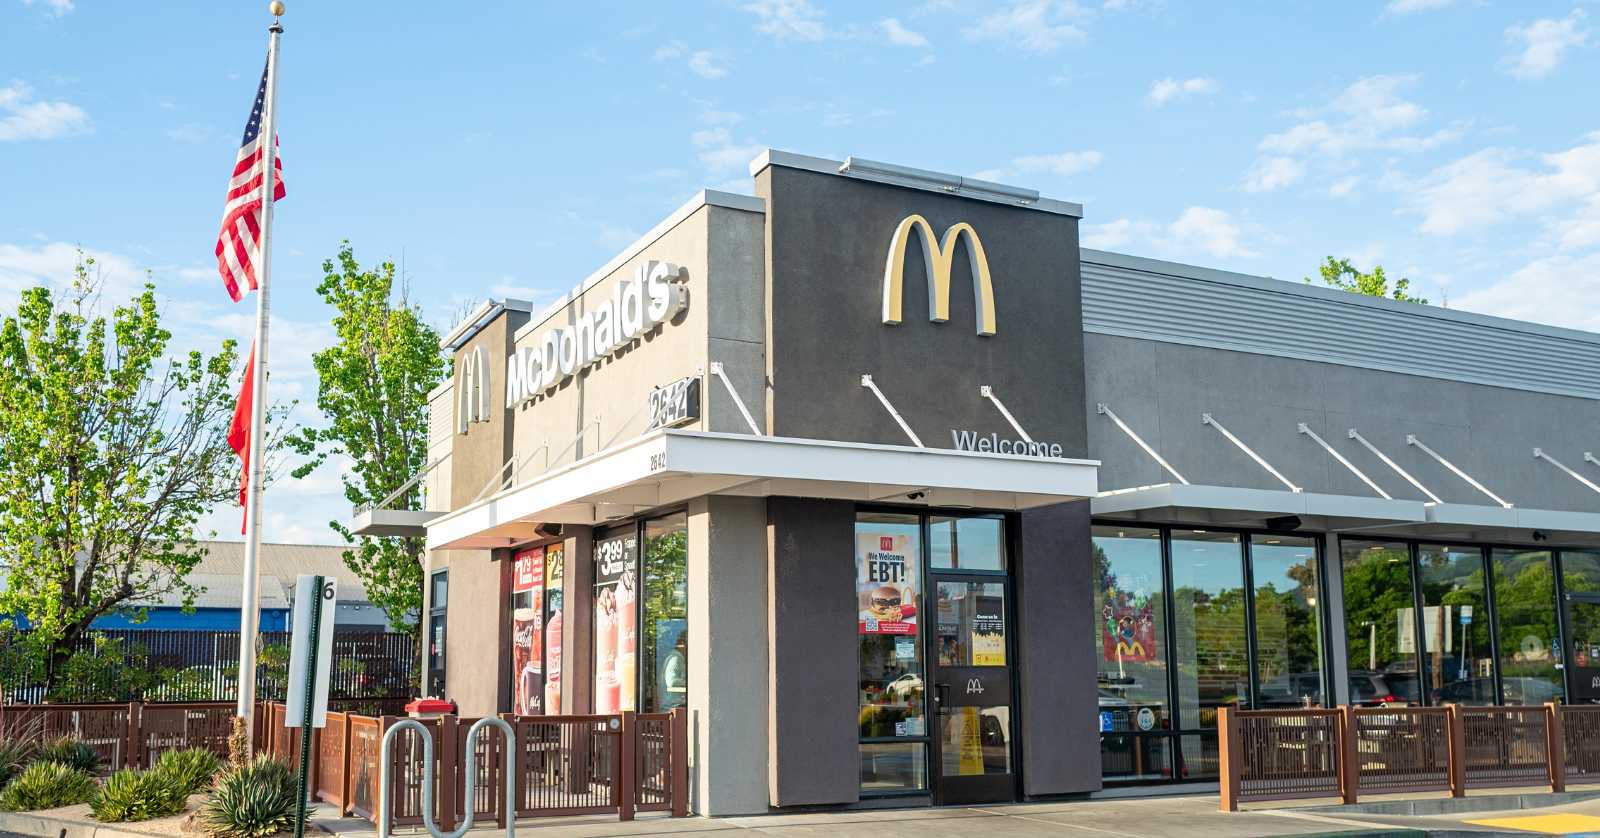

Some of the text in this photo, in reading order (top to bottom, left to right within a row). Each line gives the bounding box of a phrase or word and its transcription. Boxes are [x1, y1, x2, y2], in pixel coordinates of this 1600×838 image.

[506, 260, 680, 410] McDonald's
[652, 381, 686, 429] 2642
[951, 429, 1063, 458] Welcome
[650, 451, 666, 472] 2642
[869, 552, 905, 561] We Welcome
[869, 561, 905, 583] EBT!
